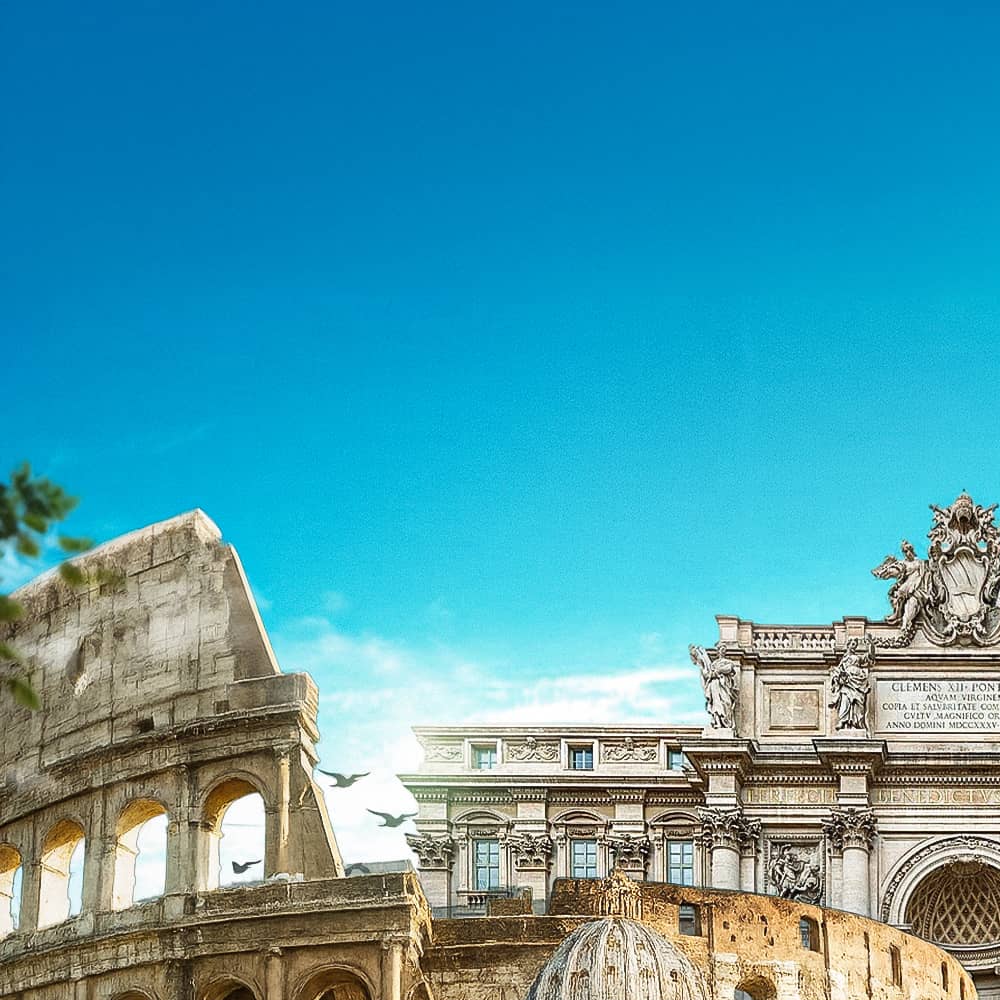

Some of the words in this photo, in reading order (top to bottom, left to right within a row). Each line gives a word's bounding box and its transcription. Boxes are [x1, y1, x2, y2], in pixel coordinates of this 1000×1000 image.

[891, 682, 942, 692] CLEMENS
[926, 693, 957, 702] AQVAM
[936, 712, 985, 720] MAGNIFICO
[885, 721, 912, 729] ANNO
[913, 721, 945, 729] DOMINI
